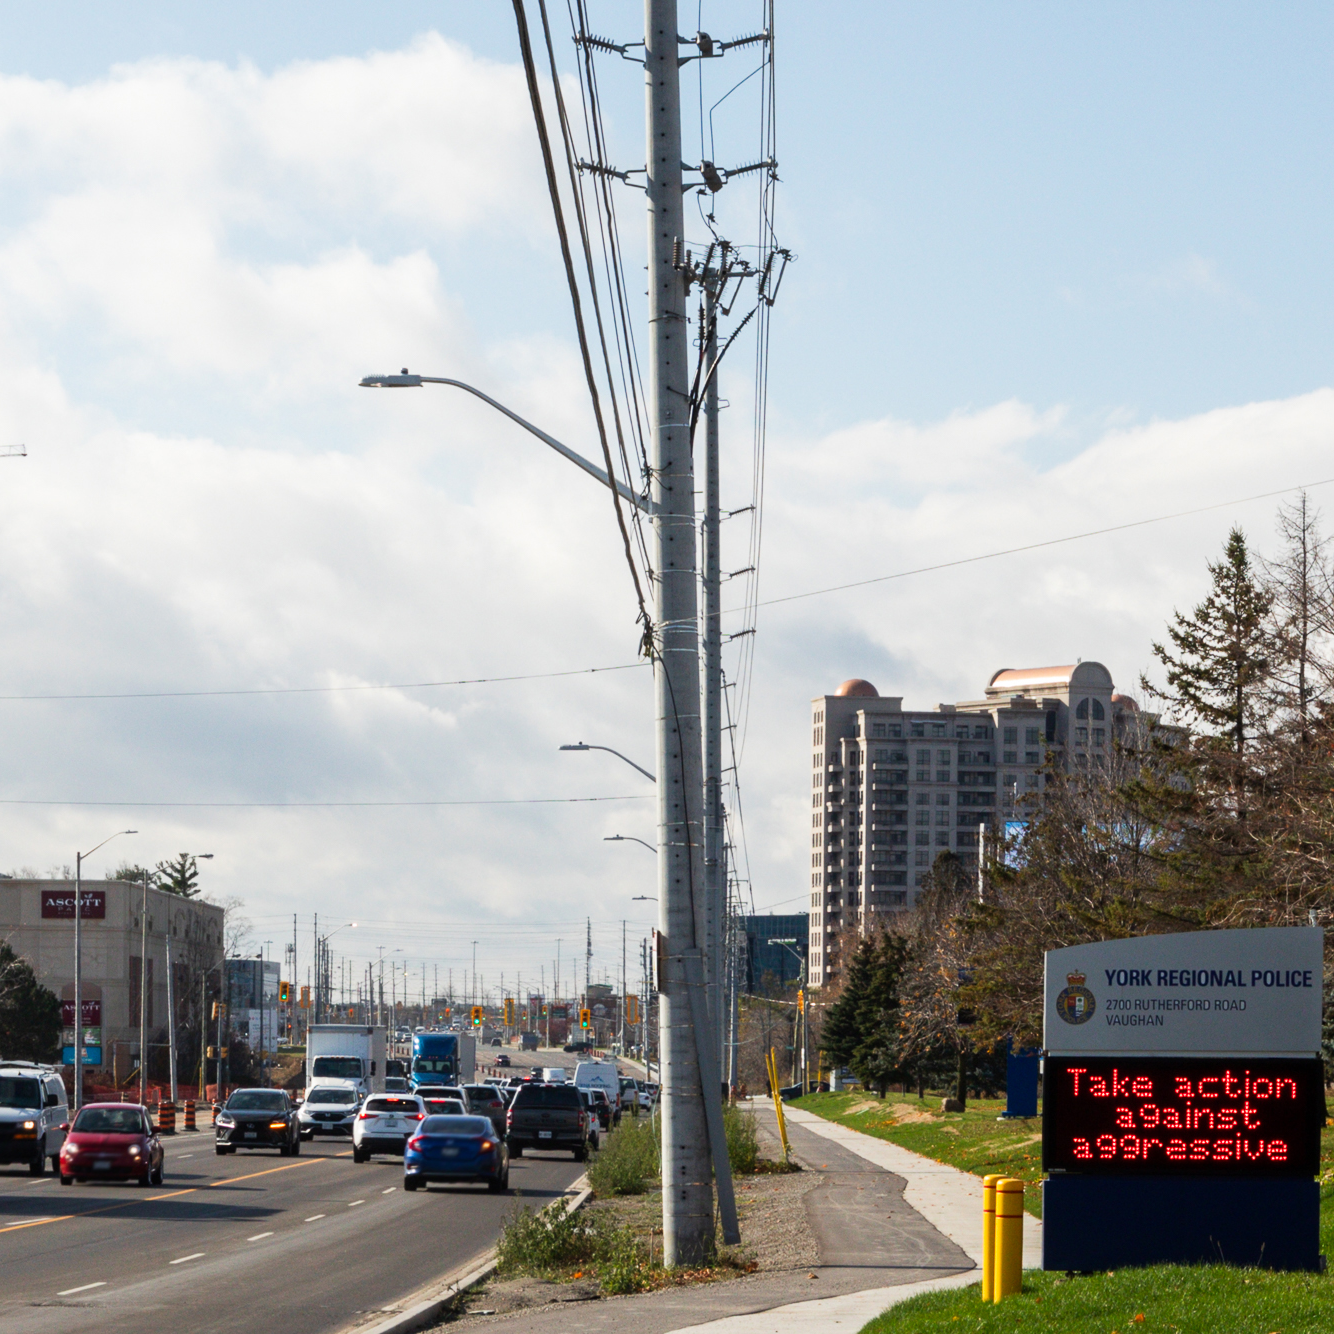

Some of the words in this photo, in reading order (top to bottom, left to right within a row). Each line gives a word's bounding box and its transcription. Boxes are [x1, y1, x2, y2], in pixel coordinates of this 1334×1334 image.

[46, 898, 102, 907] ASCOTT
[1105, 969, 1152, 987] YORK
[1156, 969, 1246, 988] REGIONAL
[1251, 970, 1313, 988] POLICE
[1106, 1000, 1132, 1011] 2700
[1134, 1000, 1211, 1011] RUTHERFORD
[1214, 1000, 1247, 1011] ROAD
[1105, 1015, 1164, 1026] VAUGHAN
[1067, 1068, 1153, 1098] Take
[1175, 1069, 1297, 1099] action
[1116, 1100, 1261, 1130] against
[1073, 1131, 1288, 1160] aggressive
